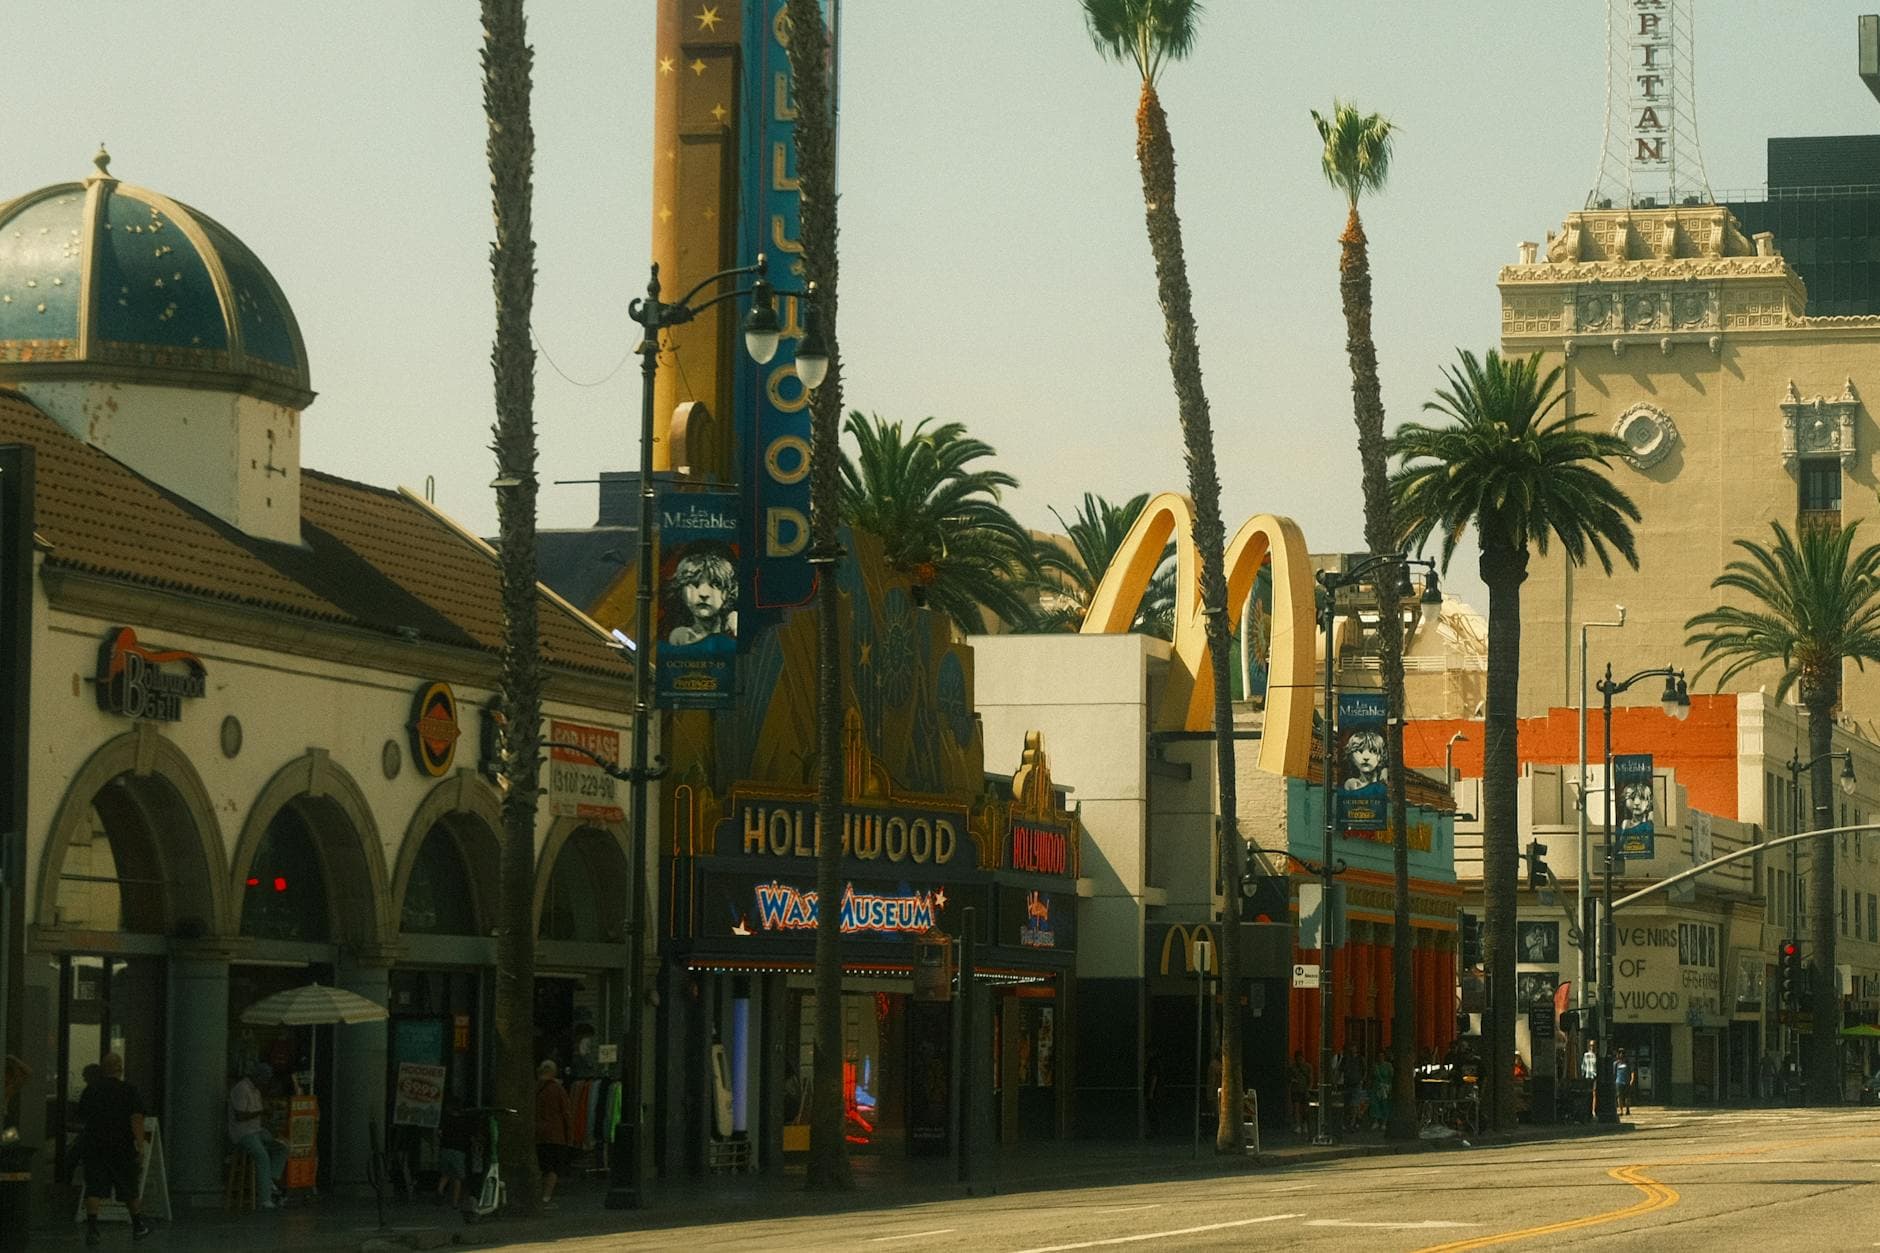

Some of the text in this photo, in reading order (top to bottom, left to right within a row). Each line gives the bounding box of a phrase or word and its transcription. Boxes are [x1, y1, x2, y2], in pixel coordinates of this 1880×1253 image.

[1633, 0, 1667, 163] PITAN
[664, 512, 737, 529] Misérables
[1619, 959, 1646, 977] OF
